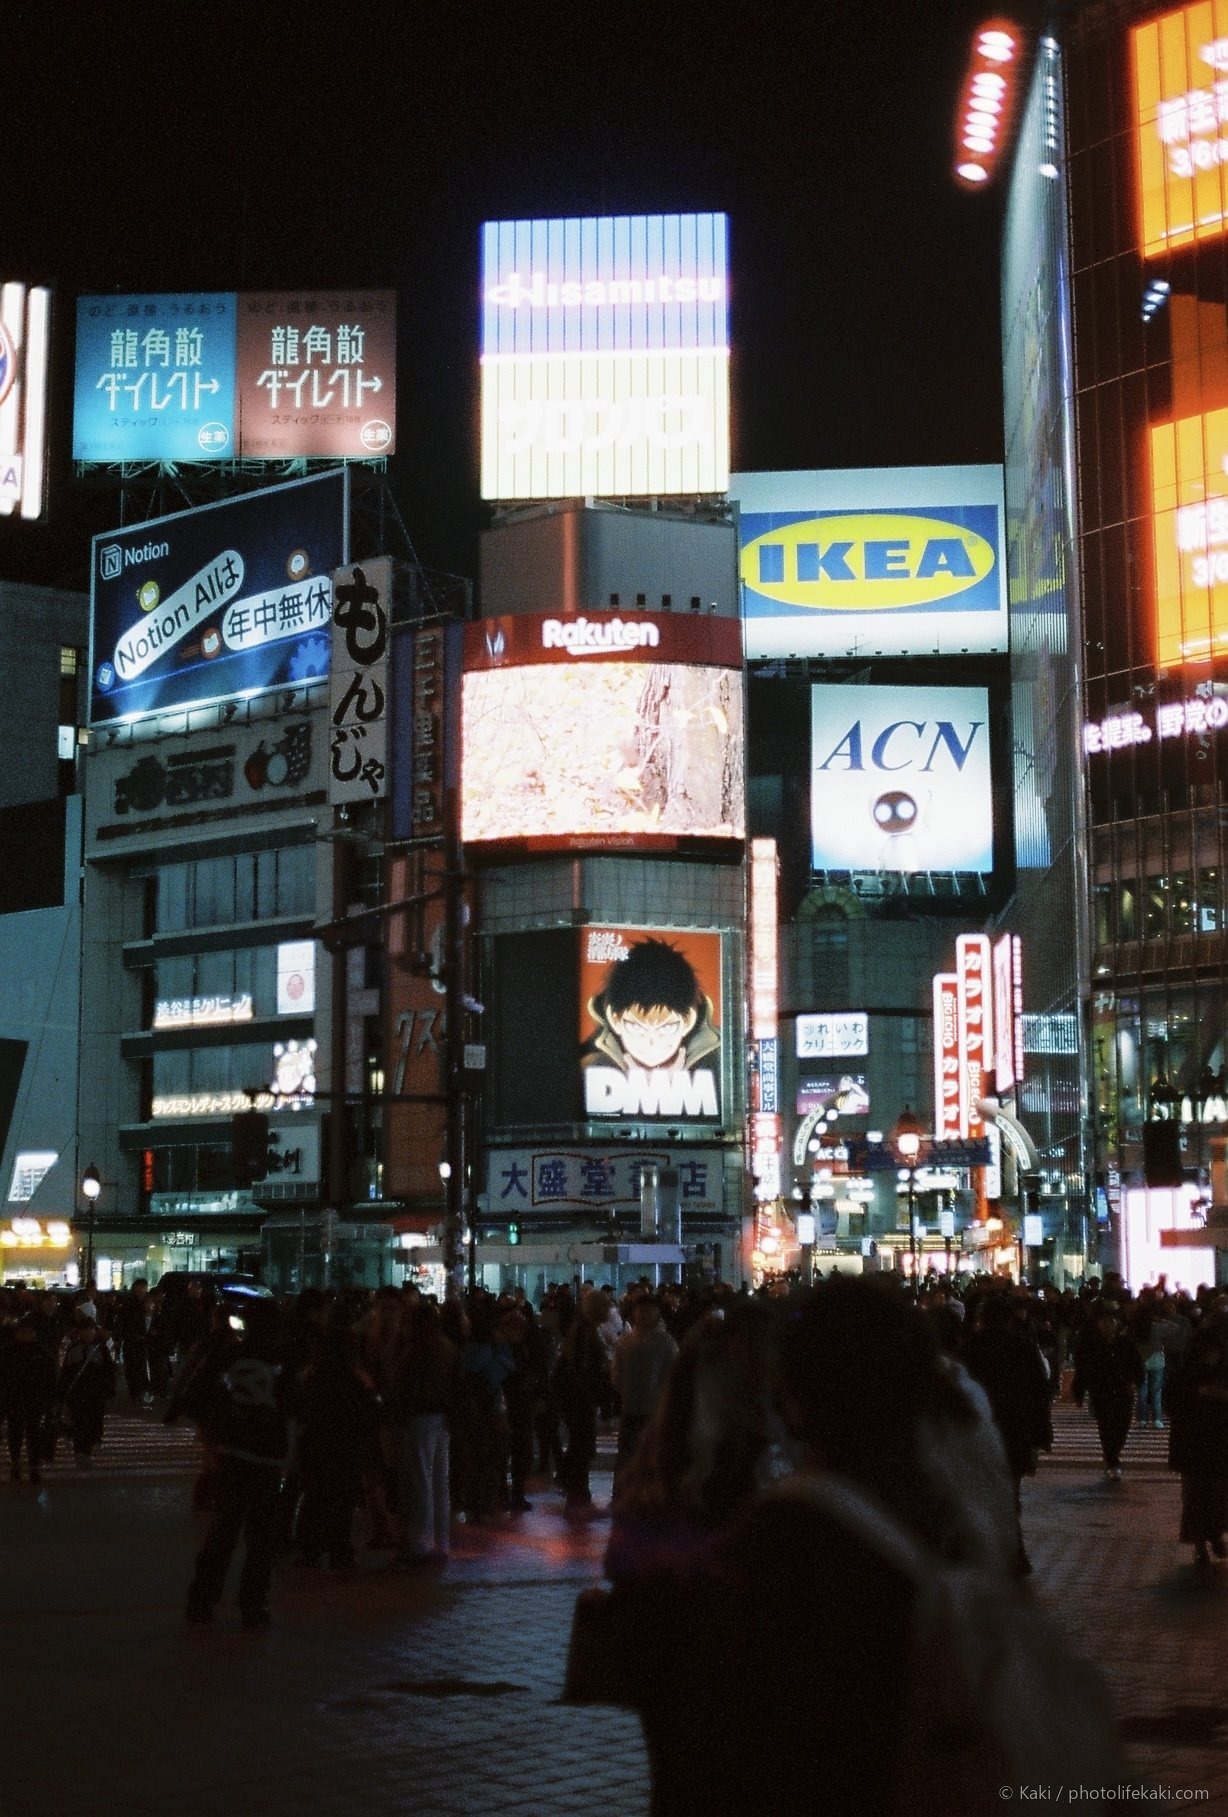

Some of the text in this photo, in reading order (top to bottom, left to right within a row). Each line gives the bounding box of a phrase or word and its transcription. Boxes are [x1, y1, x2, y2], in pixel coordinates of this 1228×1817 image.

[487, 272, 723, 308] Hisamitsu
[110, 327, 204, 369] 龍角散
[271, 325, 366, 365] 龍角散
[96, 371, 220, 411] ダイレクト
[256, 369, 382, 409] ダイレクト
[124, 541, 169, 566] Notion
[759, 538, 977, 584] IKEA
[228, 582, 332, 643] 年中無休
[542, 617, 660, 648] Rakuten
[118, 601, 190, 674] Notion
[331, 566, 387, 794] もんじゃ
[816, 719, 985, 772] ACN
[964, 952, 983, 1051] カラオケ
[804, 1038, 864, 1052] クリニック
[152, 1093, 275, 1114] ジャスミンレディースクリック
[585, 1066, 719, 1115] DMM
